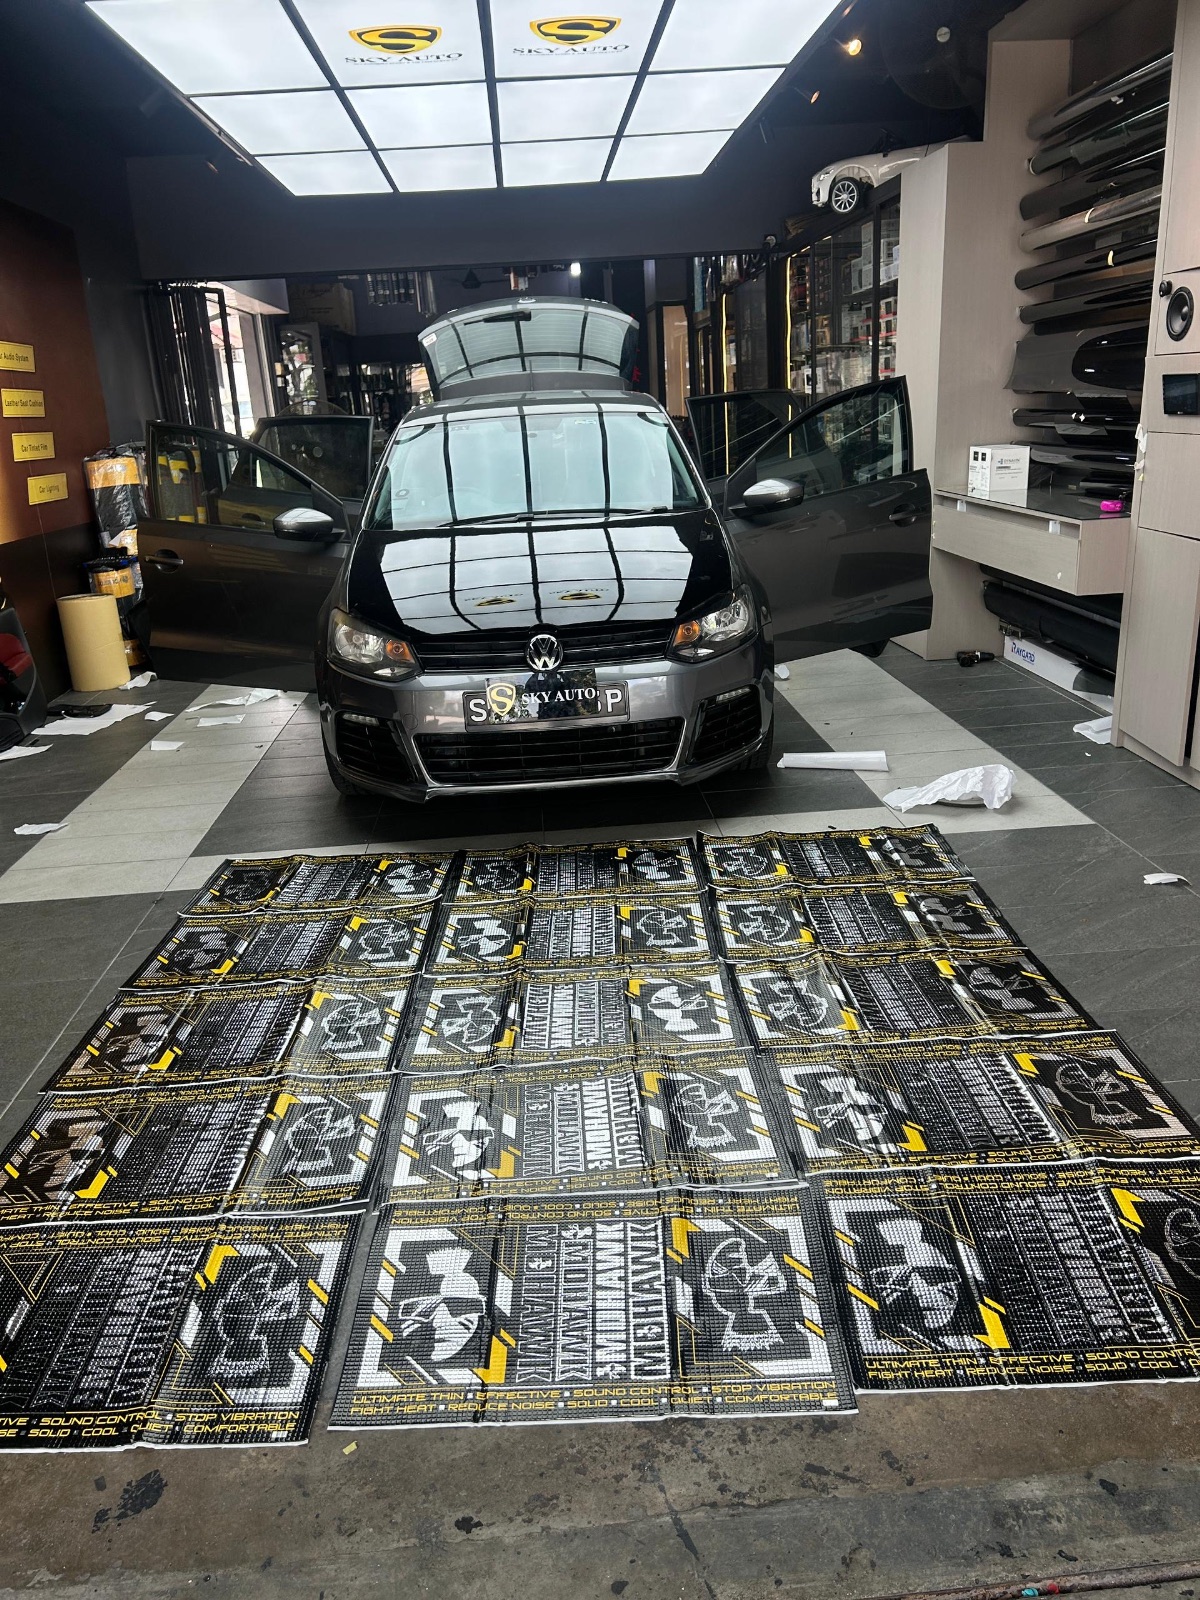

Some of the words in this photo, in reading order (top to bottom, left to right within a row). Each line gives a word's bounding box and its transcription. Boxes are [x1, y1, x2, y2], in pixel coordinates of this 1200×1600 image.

[512, 47, 559, 55] SKY
[563, 44, 630, 54] AUTO
[344, 56, 391, 64] SKY
[397, 52, 463, 63] AUTO
[21, 444, 29, 452] Car
[521, 690, 552, 705] SKY
[554, 687, 596, 702] AUTO
[469, 698, 487, 722] S
[605, 688, 623, 712] P
[582, 1078, 612, 1160] MOHAWK
[607, 1072, 648, 1169] MOHAWK
[523, 1083, 552, 1177] MOHAWK
[554, 1090, 585, 1174] MOHAWK
[909, 1152, 980, 1162] EFFECTIVE
[987, 1149, 1031, 1158] SOUND
[1033, 1141, 1090, 1155] CONTROL
[1099, 1141, 1131, 1149] STOP
[1134, 1139, 1199, 1149] VIBRATION
[986, 1156, 1021, 1164] SOLID
[1030, 1153, 1062, 1162] COOL
[1069, 1147, 1103, 1156] QUIET
[390, 1186, 451, 1197] ULTIMATE
[454, 1183, 482, 1191] THIN
[490, 1178, 561, 1188] EFFECTIVE
[570, 1173, 615, 1183] SOUND
[616, 1166, 672, 1179] CONTROL
[716, 1161, 780, 1172] VIBRATION
[974, 1174, 1004, 1182] COOL
[1013, 1172, 1048, 1180] SOLID
[1057, 1170, 1097, 1178] NOISE
[521, 1186, 557, 1194] NOISE
[566, 1181, 600, 1190] SOLID
[649, 1172, 682, 1182] QUIET
[823, 1177, 918, 1187] COMFORTABLE
[1000, 1181, 1047, 1189] SOUND
[1055, 1177, 1128, 1187] EFFECTIVE
[1137, 1176, 1169, 1184] THIN
[825, 1185, 894, 1195] VIBRATION
[894, 1184, 930, 1193] STOP
[941, 1181, 999, 1190] CONTROL
[68, 1201, 139, 1209] EFFECTIVE
[148, 1197, 193, 1206] SOUND
[194, 1192, 254, 1203] CONTROL
[296, 1185, 361, 1198] VIBRATION
[726, 1197, 760, 1205] HEAT
[540, 1203, 574, 1211] COOL
[581, 1201, 616, 1210] SOLID
[626, 1198, 665, 1207] NOISE
[1, 1213, 35, 1221] HEAT
[95, 1208, 131, 1216] NOISE
[140, 1205, 175, 1213] SOLID
[225, 1199, 259, 1208] QUIET
[393, 1206, 488, 1217] COMFORTABLE
[568, 1209, 612, 1218] SOUND
[622, 1205, 694, 1216] EFFECTIVE
[703, 1205, 733, 1213] THIN
[737, 1204, 800, 1214] ULTIMATE
[391, 1215, 458, 1225] VIBRATION
[461, 1213, 496, 1222] STOP
[505, 1211, 565, 1220] CONTROL
[135, 1228, 171, 1236] SOLID
[284, 1229, 347, 1238] ULTIMATE
[9, 1240, 46, 1248] STOP
[57, 1237, 116, 1246] CONTROL
[116, 1236, 163, 1244] SOUND
[595, 1222, 627, 1362] MOHAWK
[516, 1224, 558, 1383] MOHAWK
[627, 1219, 671, 1380] MOHAWK
[555, 1239, 594, 1381] MOHAWK
[865, 1359, 940, 1369] ULTIMATE
[942, 1357, 978, 1366] THIN
[989, 1354, 1075, 1364] EFFECTIVE
[1085, 1351, 1140, 1361] SOUND
[868, 1370, 914, 1379] FIGHT
[914, 1369, 953, 1378] HEAT
[966, 1366, 1027, 1376] REDUCE
[1029, 1364, 1075, 1373] NOISE
[1084, 1361, 1128, 1371] SOLID
[1138, 1360, 1179, 1370] COOL
[353, 1392, 427, 1404] ULTIMATE
[431, 1391, 464, 1400] THIN
[475, 1389, 561, 1400] EFFECTIVE
[573, 1388, 628, 1398] SOUND
[629, 1386, 699, 1396] CONTROL
[711, 1384, 752, 1394] STOP
[755, 1380, 836, 1392] VIBRATION
[350, 1405, 396, 1415] FIGHT
[396, 1403, 436, 1413] HEAT
[447, 1402, 507, 1412] REDUCE
[511, 1400, 555, 1410] NOISE
[567, 1399, 608, 1408] SOLID
[620, 1398, 658, 1408] COOL
[670, 1396, 713, 1405] QUIET
[725, 1391, 839, 1403] COMFORTABLE
[39, 1417, 95, 1426] SOUND
[95, 1410, 163, 1425] CONTROL
[174, 1412, 218, 1422] STOP
[221, 1411, 300, 1421] VIBRATION
[28, 1428, 71, 1437] SOLID
[81, 1427, 119, 1437] COOL
[130, 1422, 174, 1433] QUIET
[183, 1422, 297, 1433] COMFORTABLE
